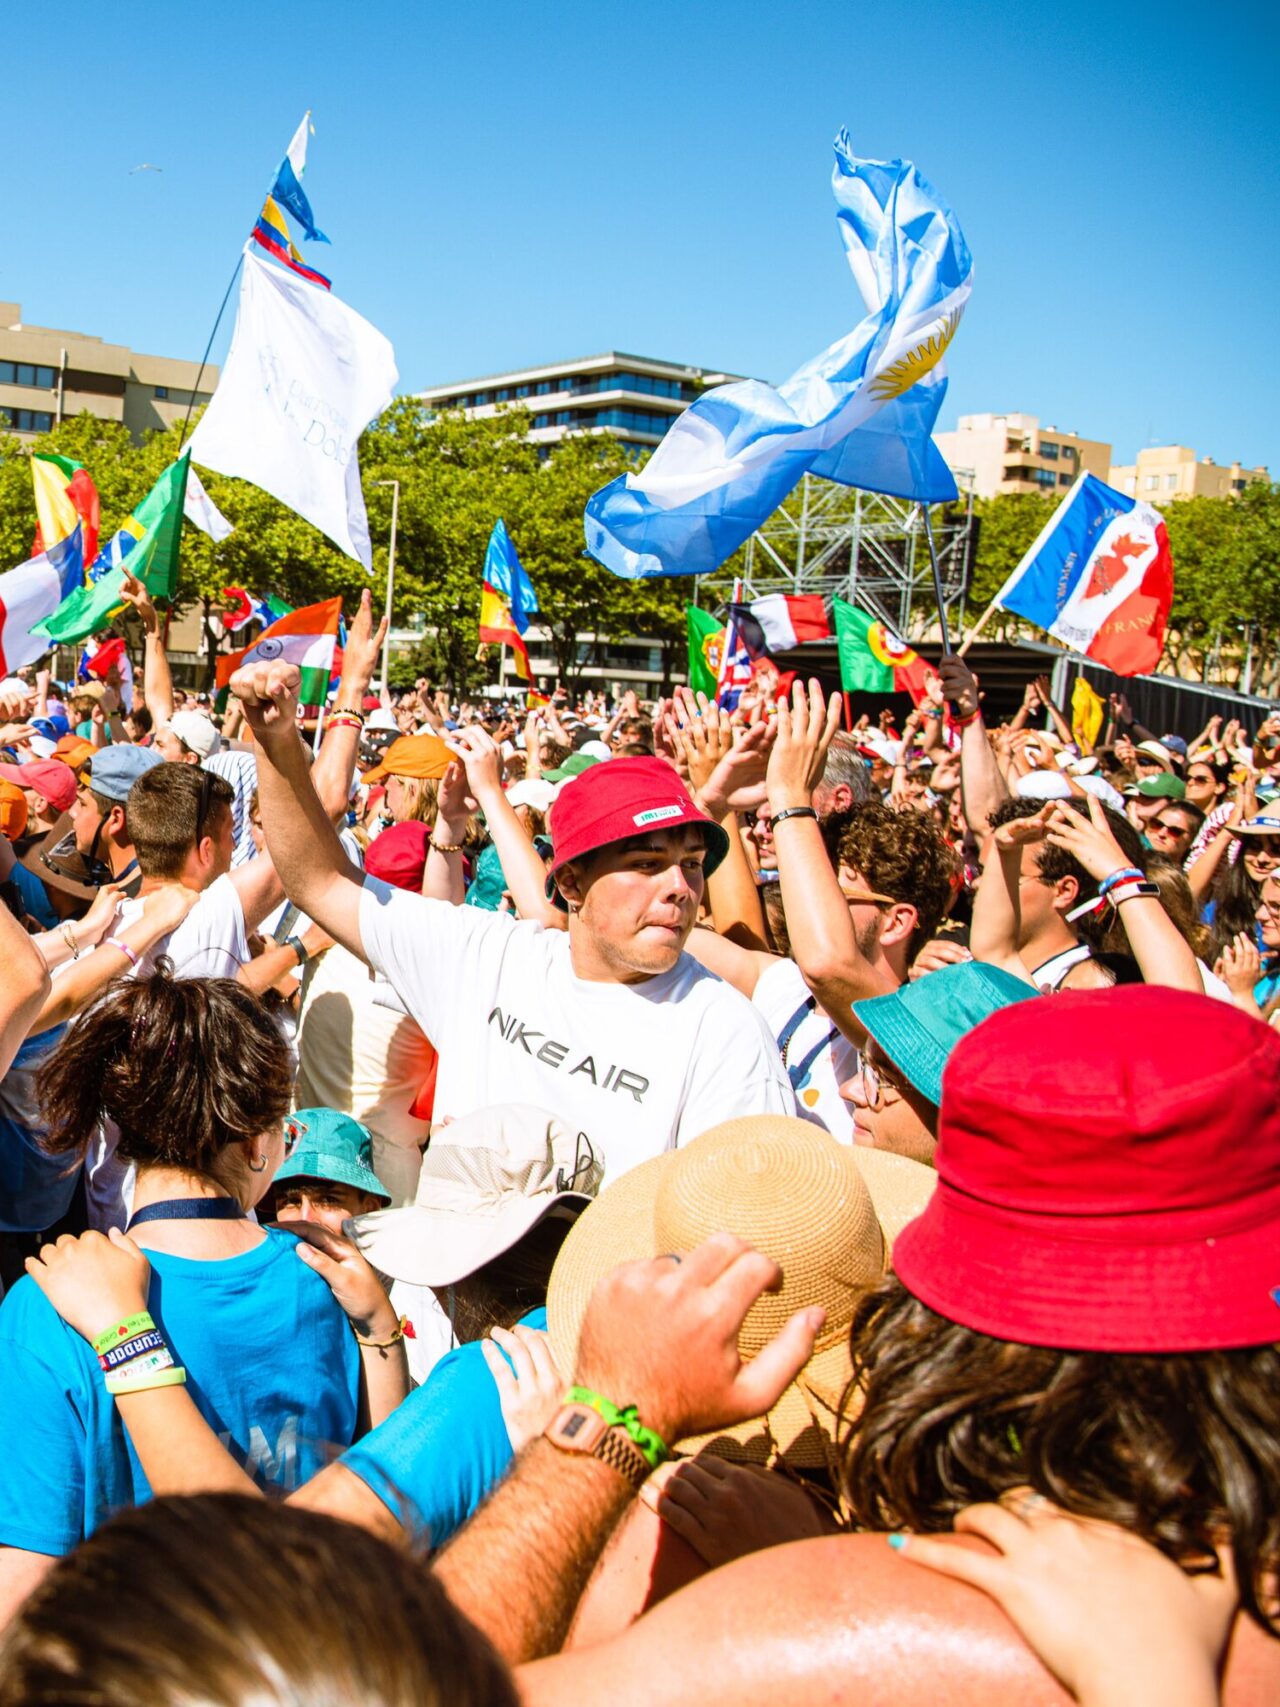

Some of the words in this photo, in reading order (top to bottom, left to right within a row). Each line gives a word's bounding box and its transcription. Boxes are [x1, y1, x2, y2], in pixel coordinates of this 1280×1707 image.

[487, 1006, 570, 1068] NIKE
[568, 1055, 650, 1104] AIR
[106, 1331, 164, 1366] ECUADOR
